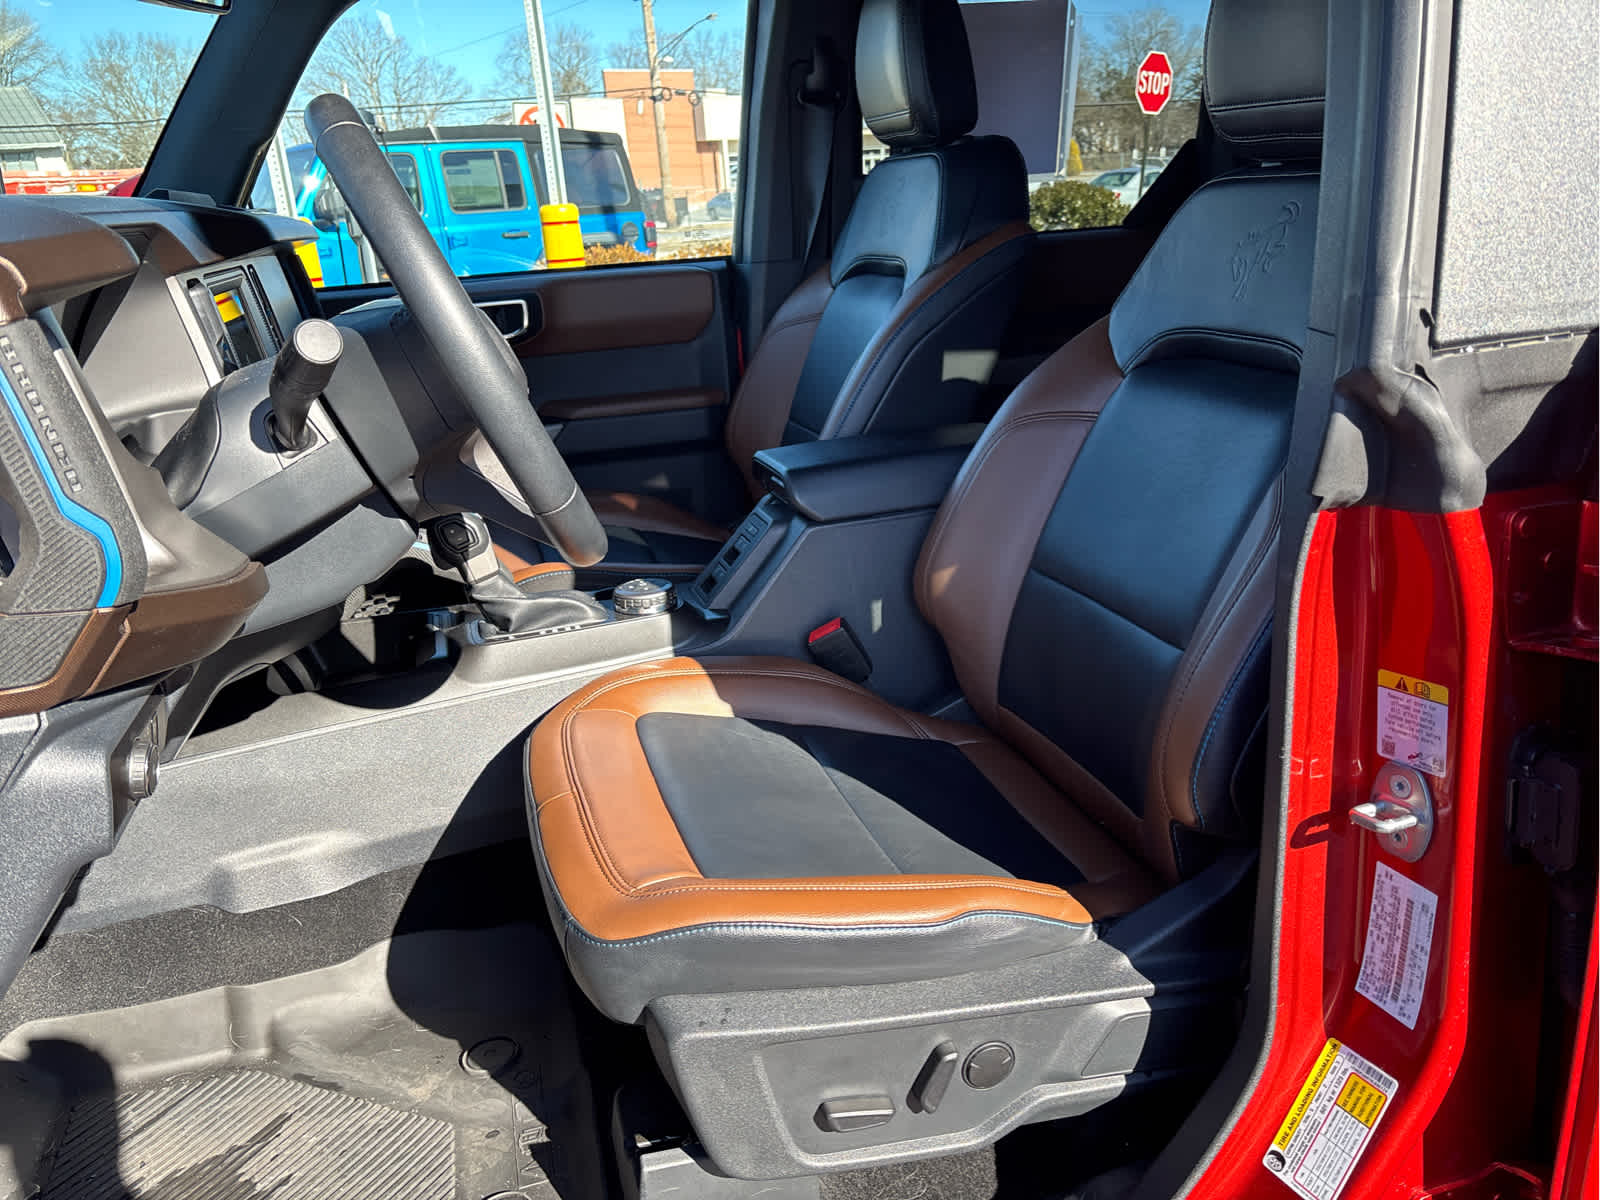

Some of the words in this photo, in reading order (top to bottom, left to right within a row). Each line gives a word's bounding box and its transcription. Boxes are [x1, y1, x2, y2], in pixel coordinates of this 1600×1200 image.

[1138, 70, 1170, 95] STOP
[0, 336, 83, 493] BRONCO
[1278, 1131, 1289, 1147] TIRE
[1287, 1116, 1297, 1131] AND
[1296, 1087, 1314, 1116] LOADING
[1311, 1042, 1338, 1087] INFORMATION
